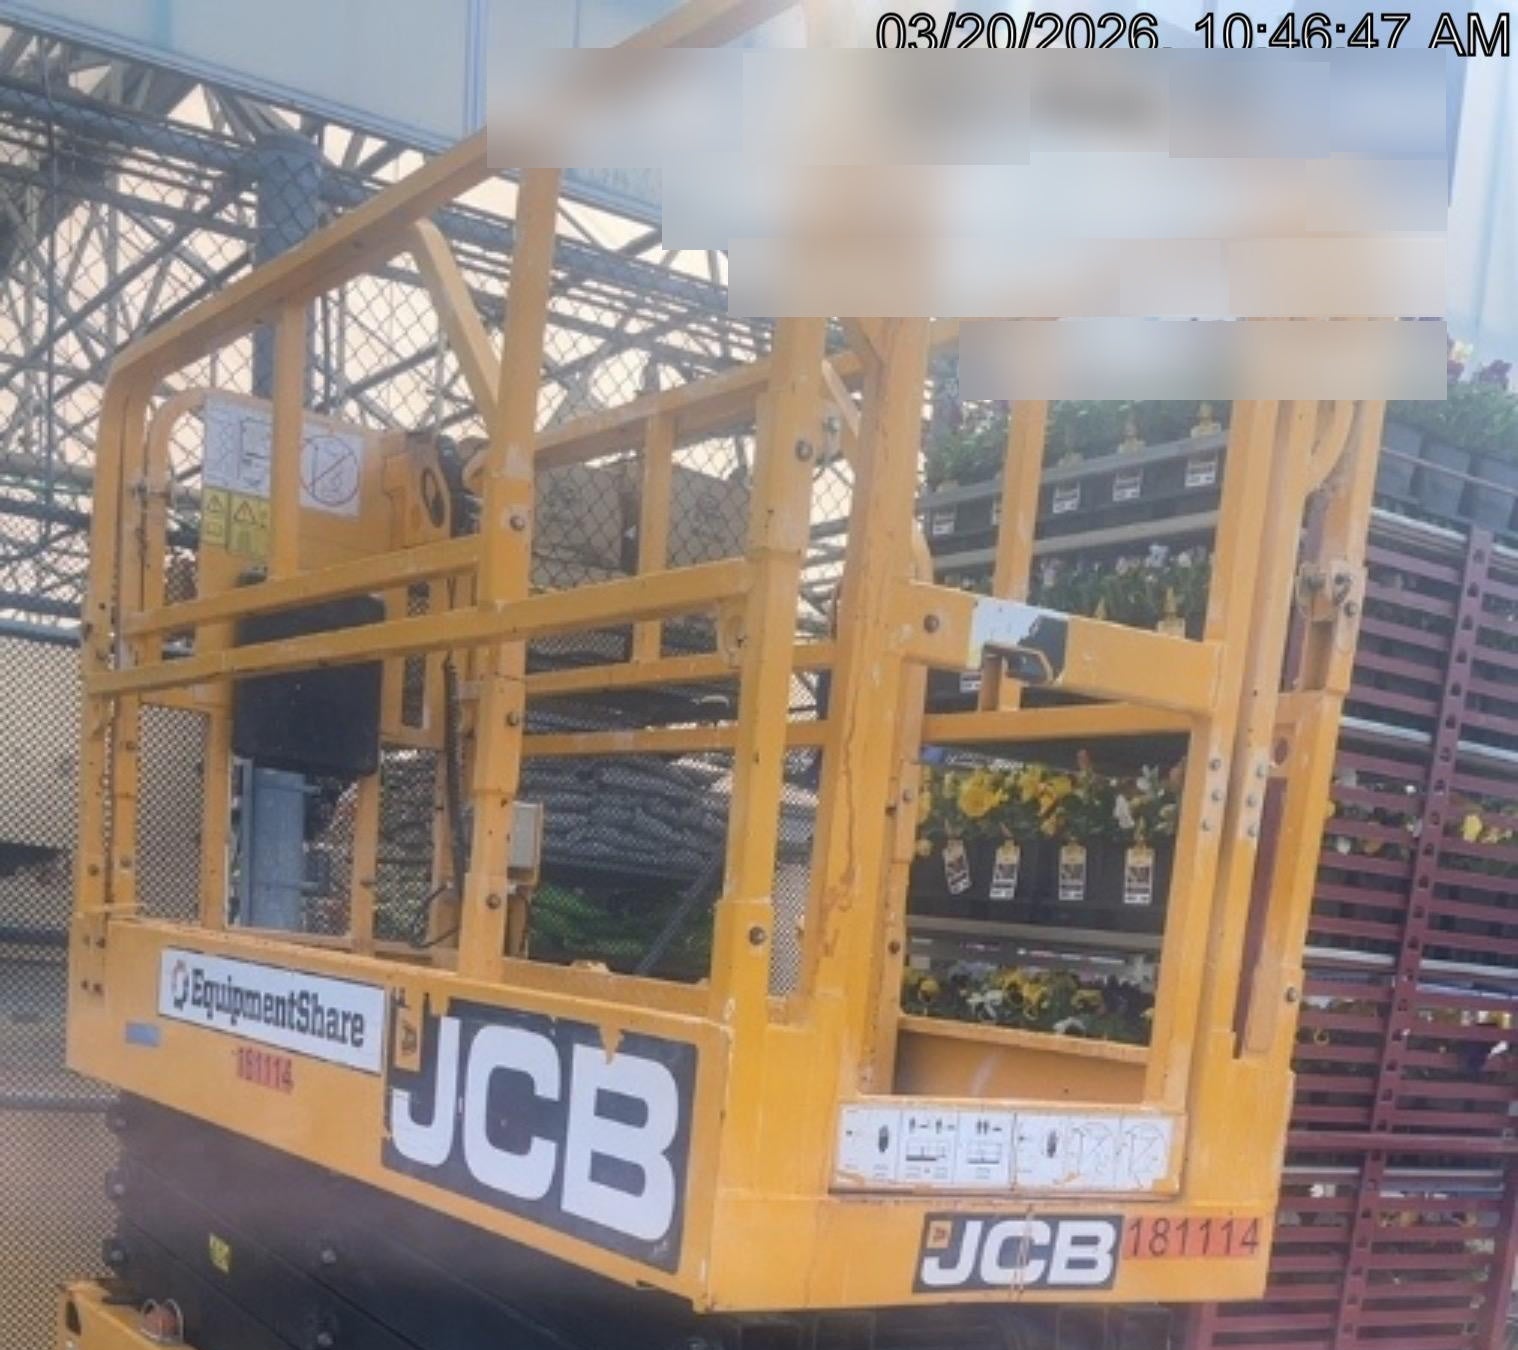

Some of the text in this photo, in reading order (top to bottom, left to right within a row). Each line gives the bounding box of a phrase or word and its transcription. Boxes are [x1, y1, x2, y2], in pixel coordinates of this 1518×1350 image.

[191, 967, 365, 1048] EquipmentShare
[391, 1016, 679, 1241] JCB
[921, 1220, 1117, 1286] JCB
[1129, 1216, 1260, 1257] 181114
